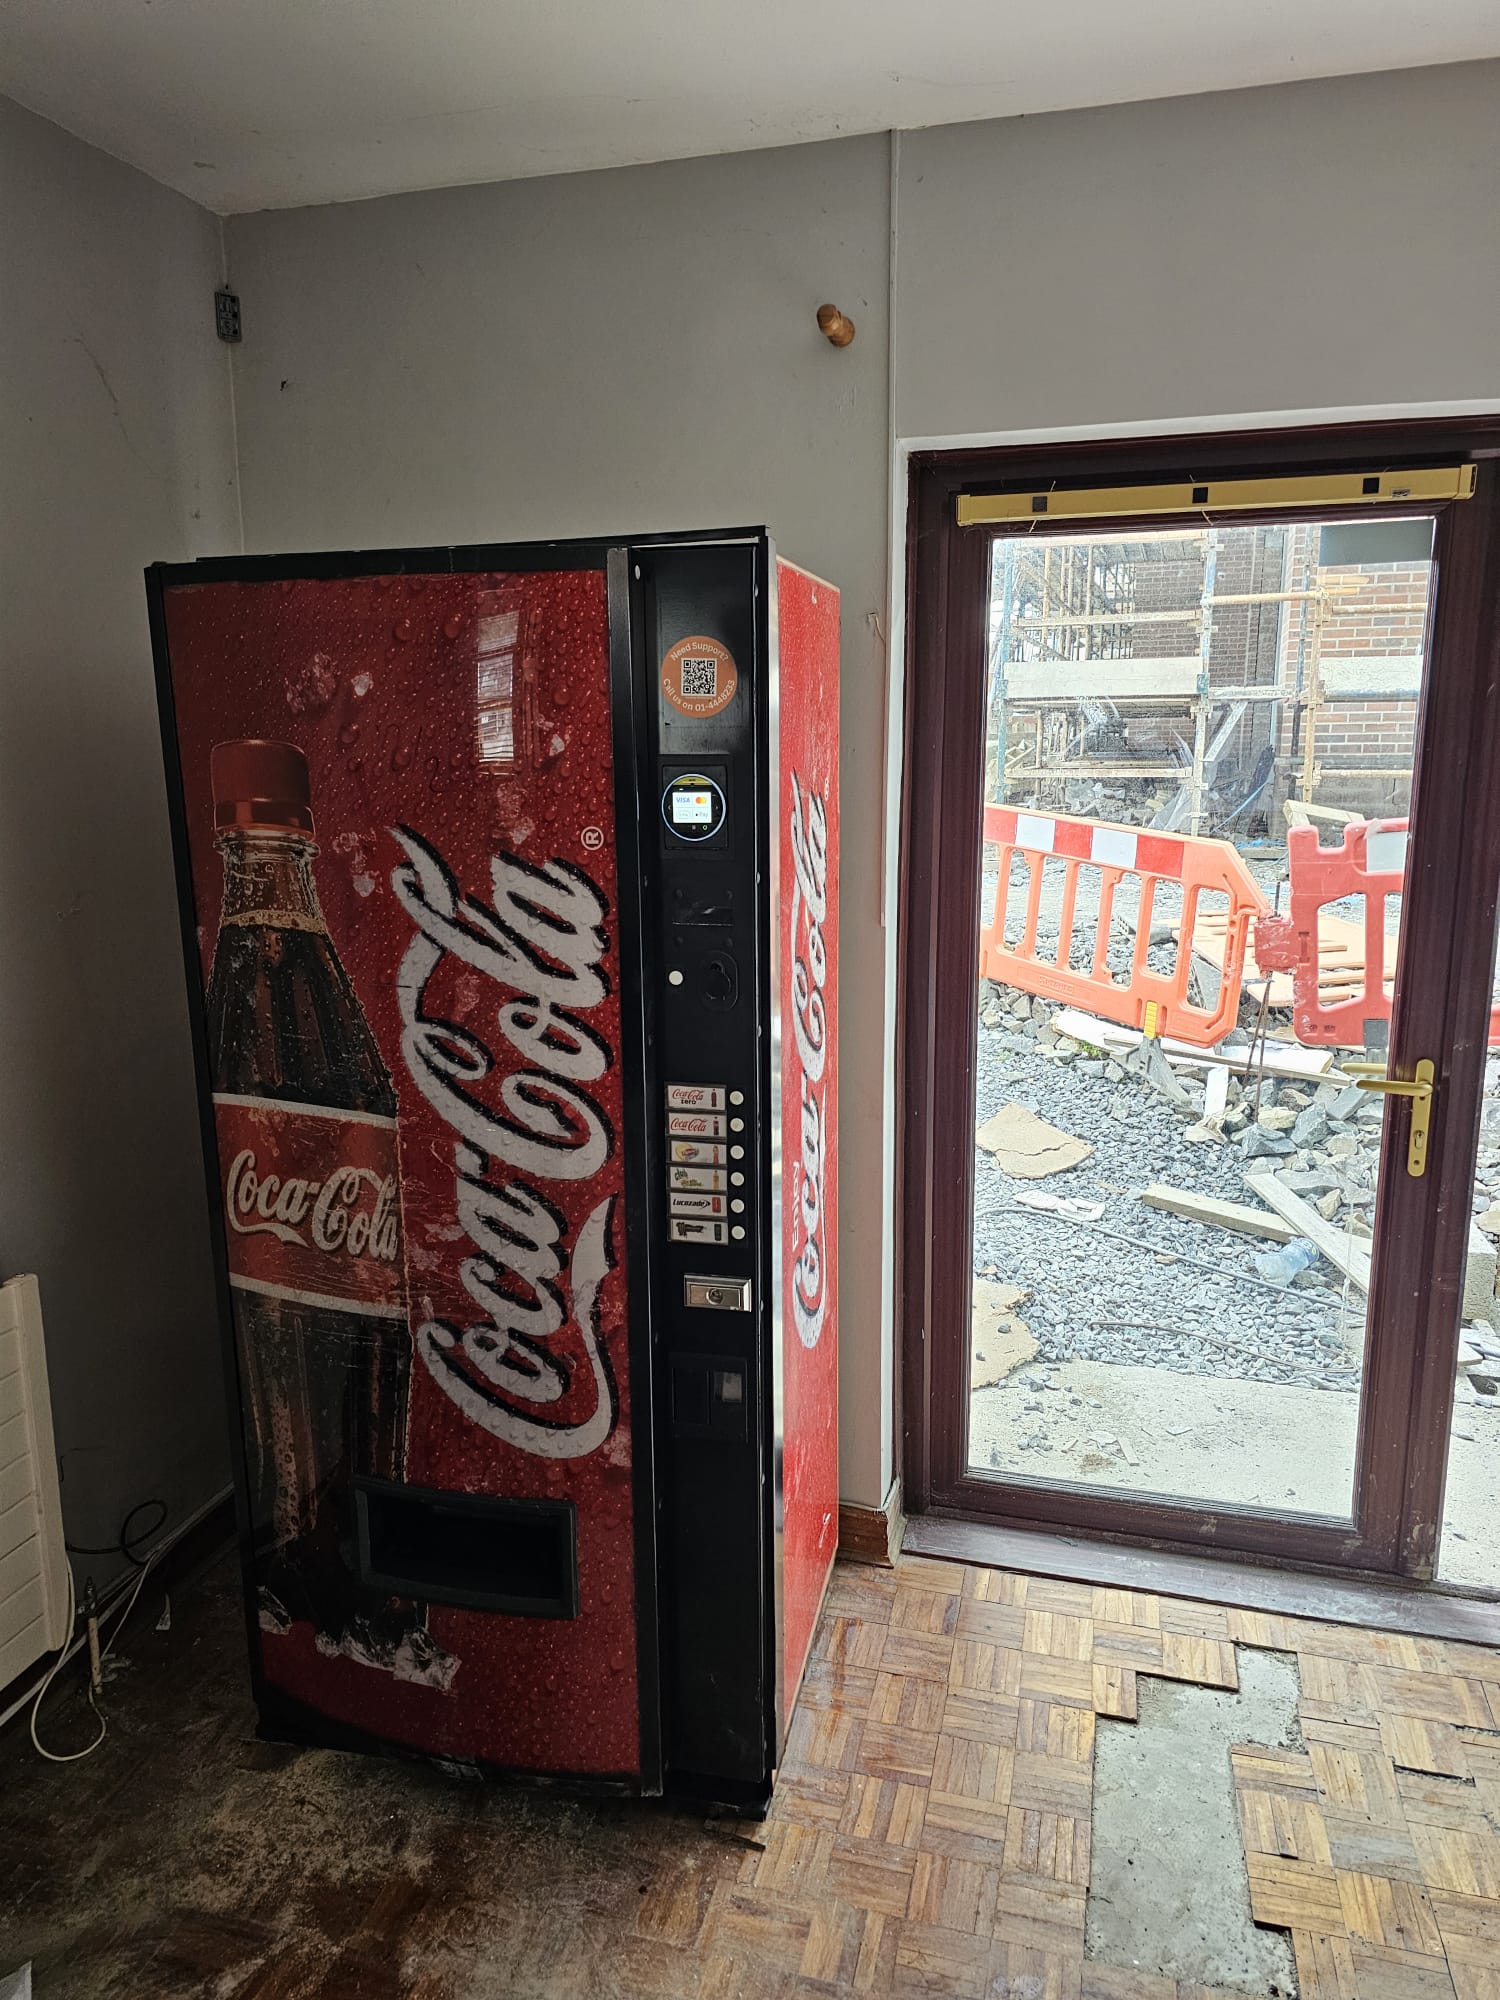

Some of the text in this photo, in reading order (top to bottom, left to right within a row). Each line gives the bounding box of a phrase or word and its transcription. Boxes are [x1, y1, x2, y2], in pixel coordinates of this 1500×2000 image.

[670, 641, 729, 662] Need Support?
[663, 678, 736, 712] Call us on 01-4448233
[676, 796, 691, 804] VISA
[791, 766, 828, 1349] Coca-Cola
[388, 823, 618, 1460] Coca-Cola
[227, 1149, 399, 1262] Coca-Cola
